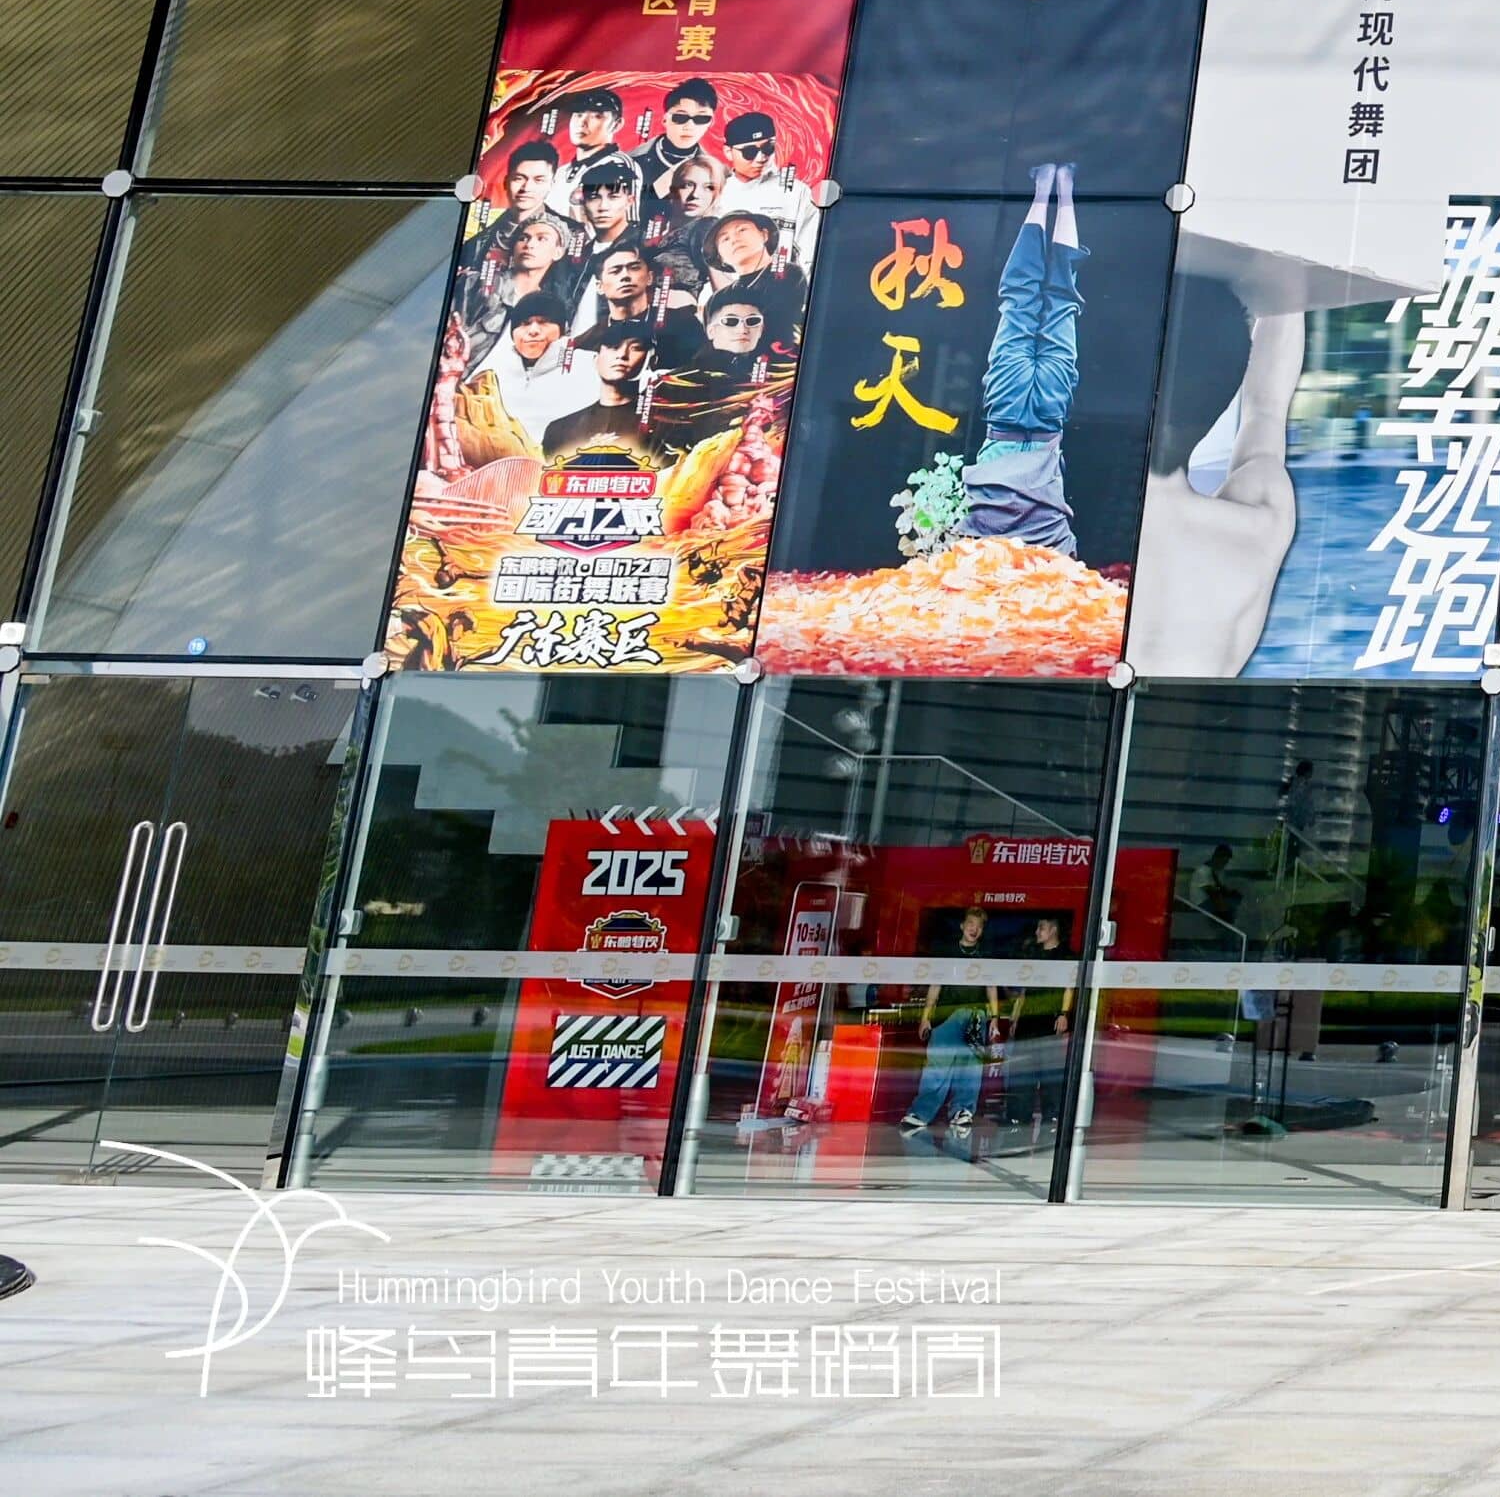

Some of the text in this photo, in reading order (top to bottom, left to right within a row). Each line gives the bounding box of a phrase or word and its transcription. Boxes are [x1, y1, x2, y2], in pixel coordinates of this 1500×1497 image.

[850, 216, 966, 434] 秋天
[992, 842, 1091, 865] 东鹏特饮
[582, 851, 689, 895] 2025
[568, 1044, 645, 1060] JUST DANCE
